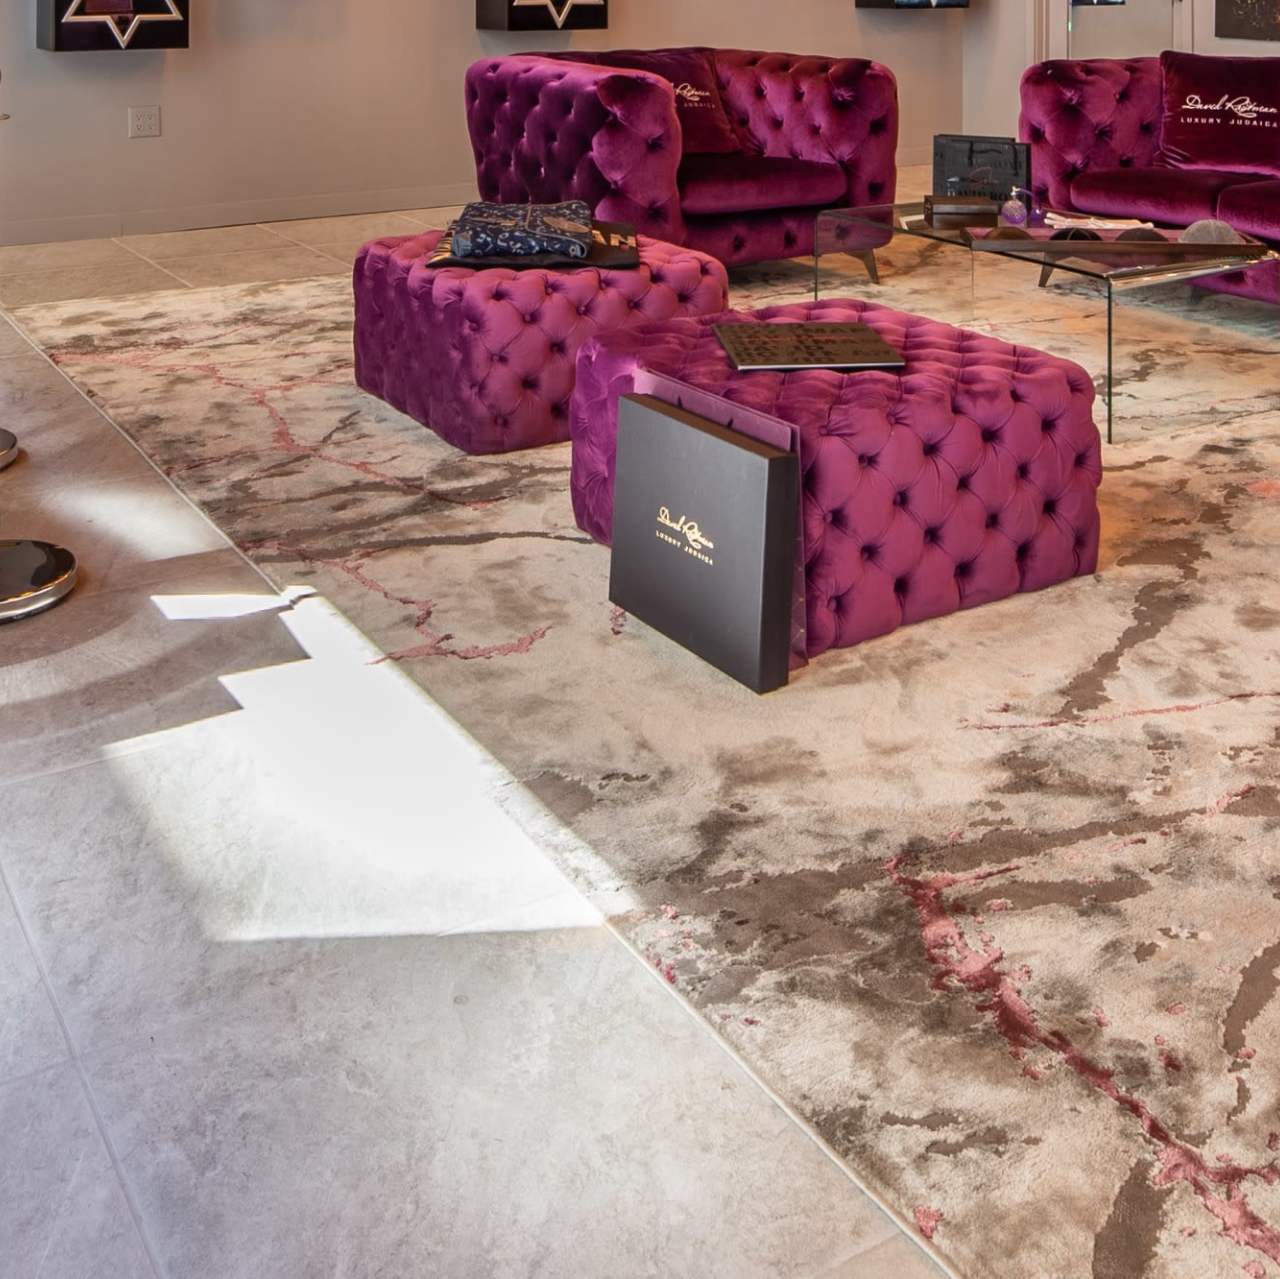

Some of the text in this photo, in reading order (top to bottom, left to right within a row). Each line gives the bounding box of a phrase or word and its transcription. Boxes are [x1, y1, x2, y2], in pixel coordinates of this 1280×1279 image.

[1181, 94, 1229, 110] David
[1229, 119, 1278, 127] JUDAICA
[656, 506, 686, 531] David
